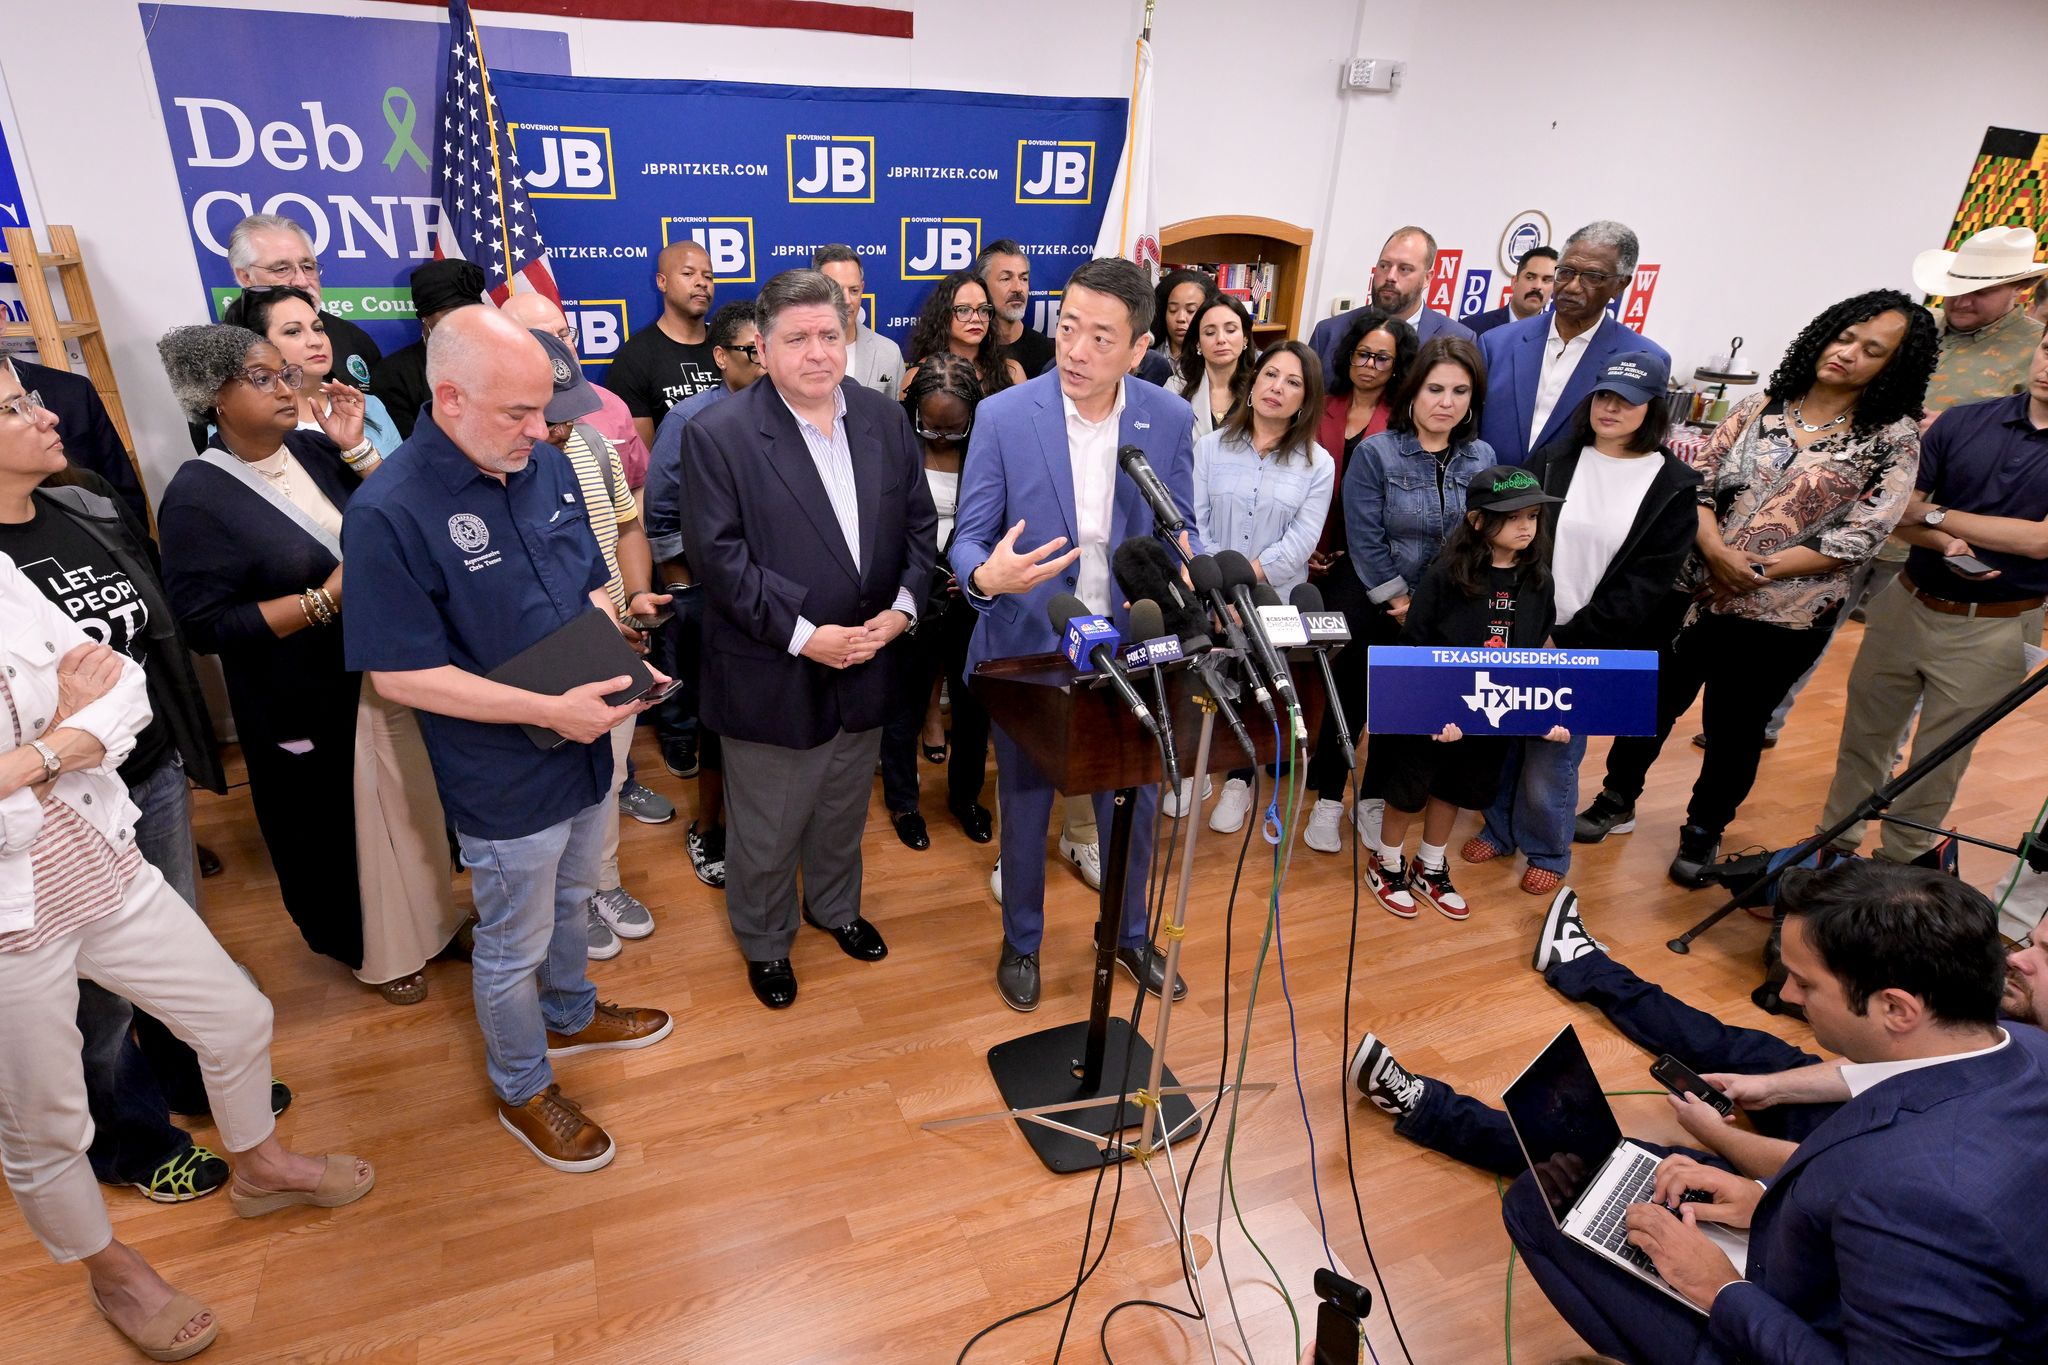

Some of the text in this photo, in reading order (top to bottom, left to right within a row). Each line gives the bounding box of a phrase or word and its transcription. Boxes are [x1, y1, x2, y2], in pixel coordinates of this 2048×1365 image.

[174, 97, 364, 172] Deb
[520, 123, 559, 131] GOVERNOR
[524, 137, 604, 188] JB
[641, 163, 769, 176] JBPRITZKER.COM
[796, 147, 866, 193] JB
[887, 166, 999, 180] JBPRITZKER.COM
[1023, 151, 1086, 195] JB
[908, 228, 972, 272] JB
[690, 371, 713, 382] LET
[1624, 367, 1648, 377] SCHOOLS
[662, 384, 694, 398] THE
[463, 550, 501, 566] Representative
[48, 565, 98, 595] LET
[1093, 619, 1109, 630] 5
[1306, 616, 1346, 629] WGN
[1070, 627, 1080, 645] 5
[1149, 640, 1179, 655] FOX 32
[1126, 650, 1140, 664] FOX
[1432, 650, 1600, 666] TEXASHOUSEDEMS.com
[1479, 687, 1573, 711] TXHDC
